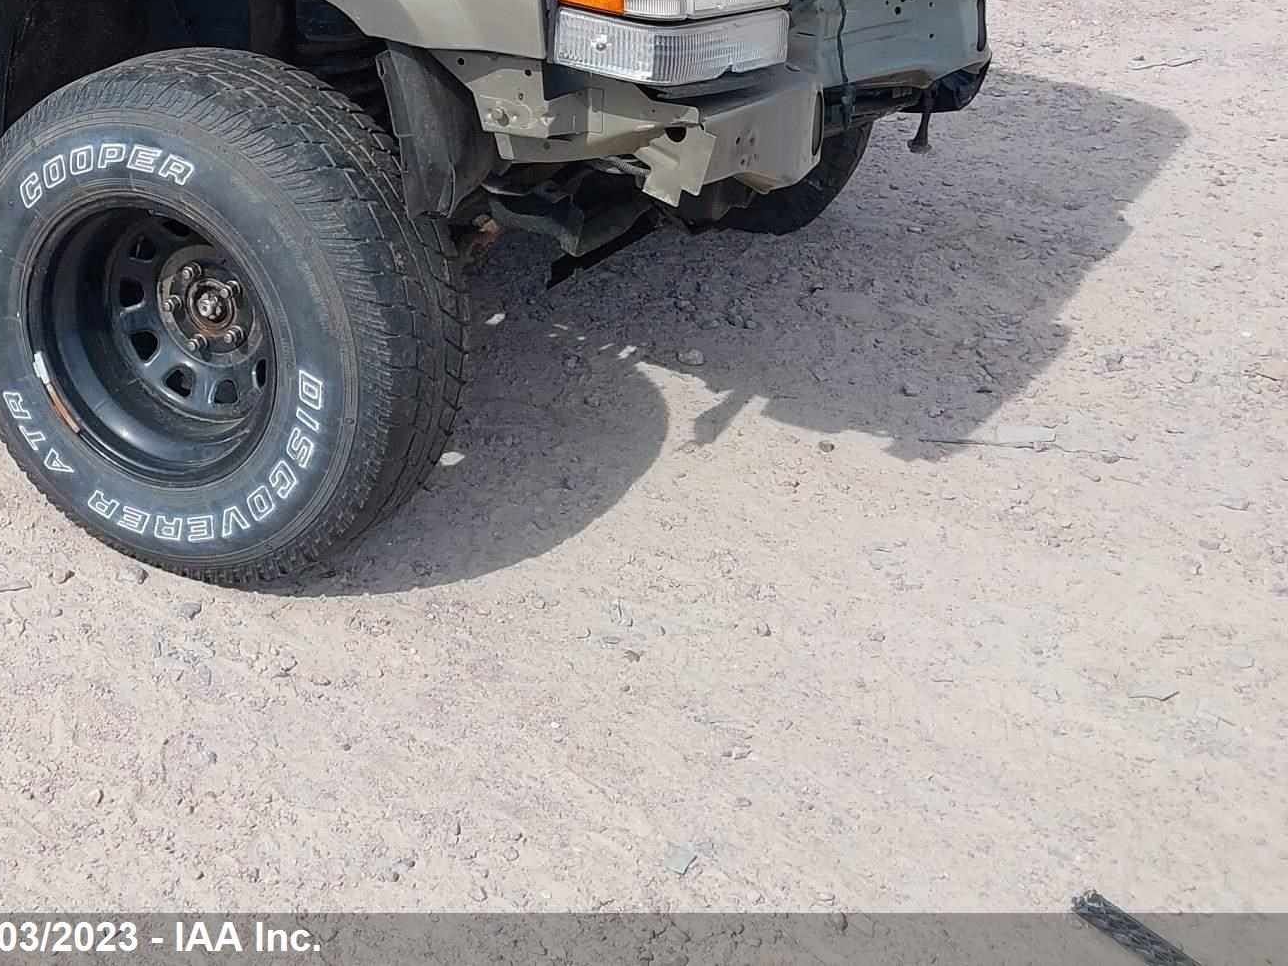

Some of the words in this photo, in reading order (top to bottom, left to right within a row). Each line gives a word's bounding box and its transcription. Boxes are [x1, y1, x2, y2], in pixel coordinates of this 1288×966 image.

[19, 142, 197, 209] COOPER
[1, 389, 76, 475] ATR
[87, 368, 326, 543] DISCOVERER
